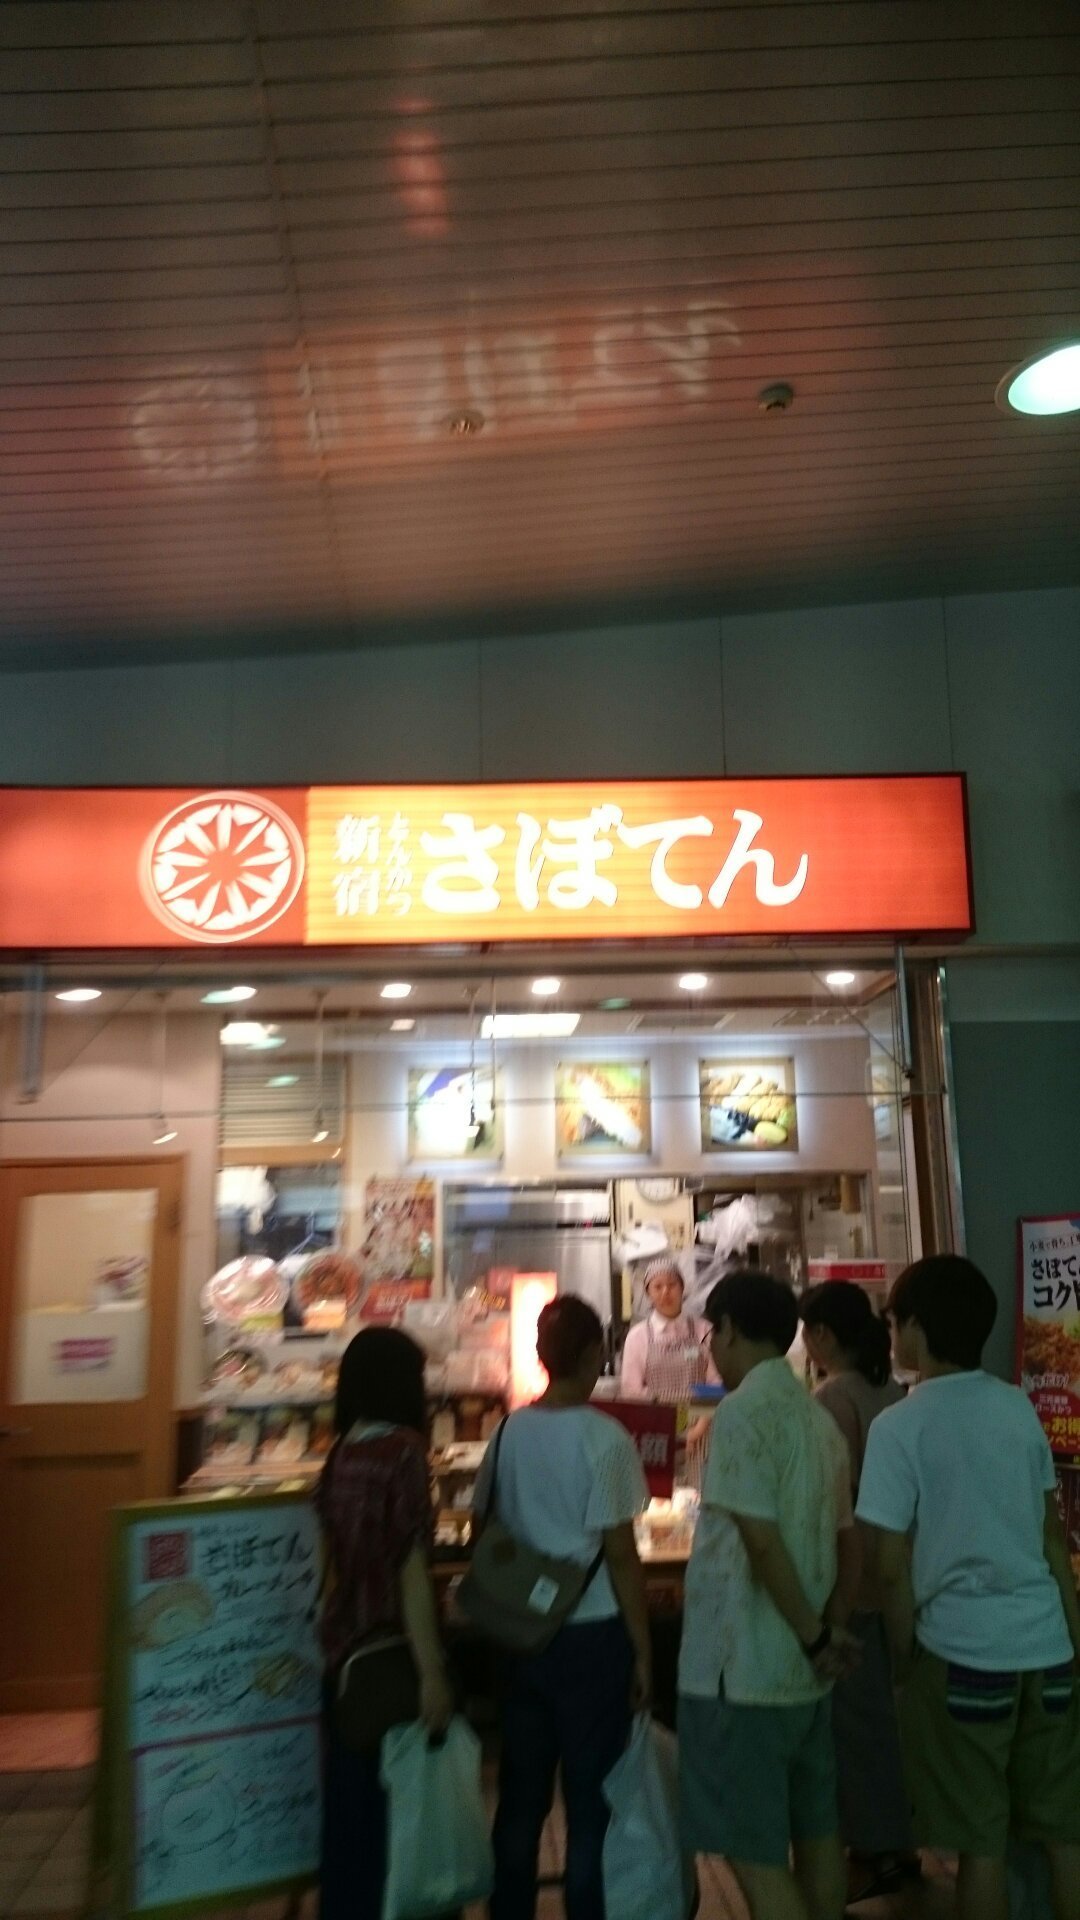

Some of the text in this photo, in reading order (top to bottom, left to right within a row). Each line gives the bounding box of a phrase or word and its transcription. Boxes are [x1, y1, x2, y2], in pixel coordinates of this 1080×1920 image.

[333, 812, 380, 917] 新宿
[386, 811, 413, 916] とんかつ
[420, 803, 808, 912] さぼてん
[1031, 1255, 1080, 1280] さぼて
